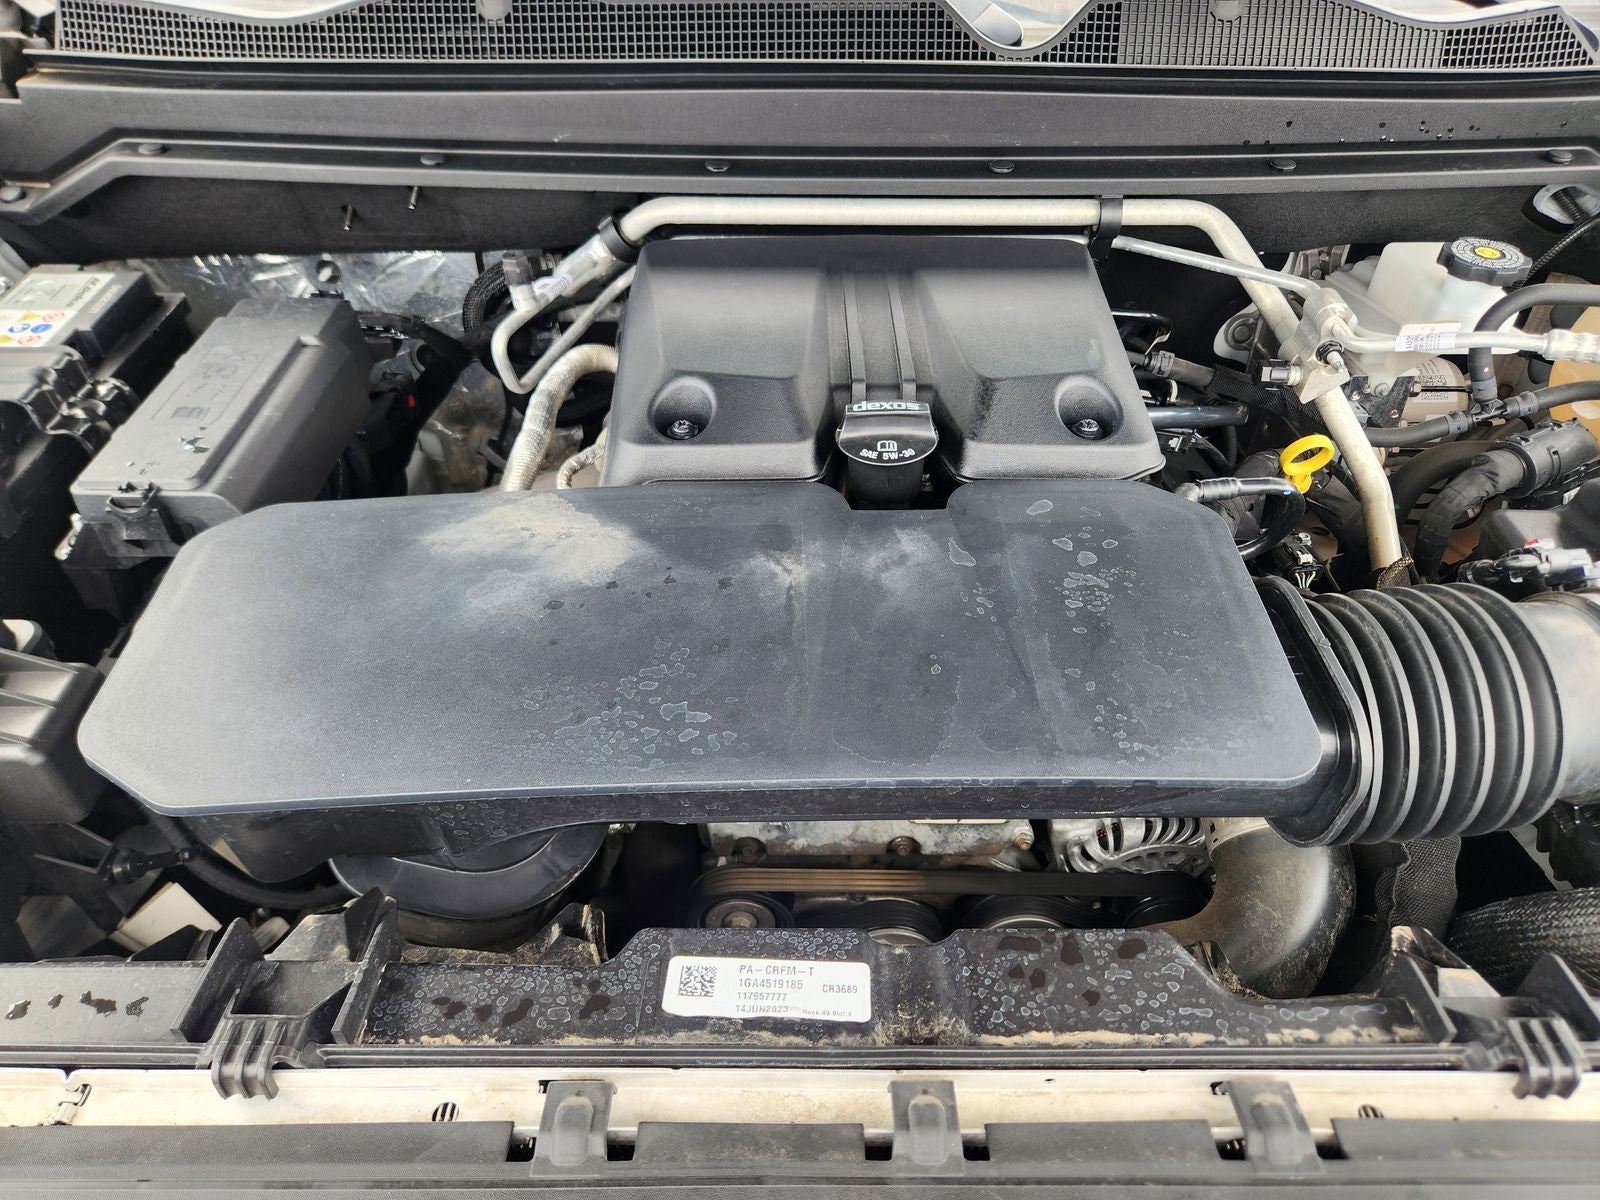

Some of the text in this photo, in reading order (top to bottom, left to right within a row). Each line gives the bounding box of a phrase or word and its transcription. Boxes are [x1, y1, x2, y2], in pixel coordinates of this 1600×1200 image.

[852, 401, 921, 412] dexos
[859, 448, 916, 460] SAE 5W-30
[738, 978, 804, 990] 1GA4519185
[822, 983, 858, 994] CR3689
[737, 991, 788, 1002] 117957777
[735, 1004, 789, 1014] 14JUN2023
